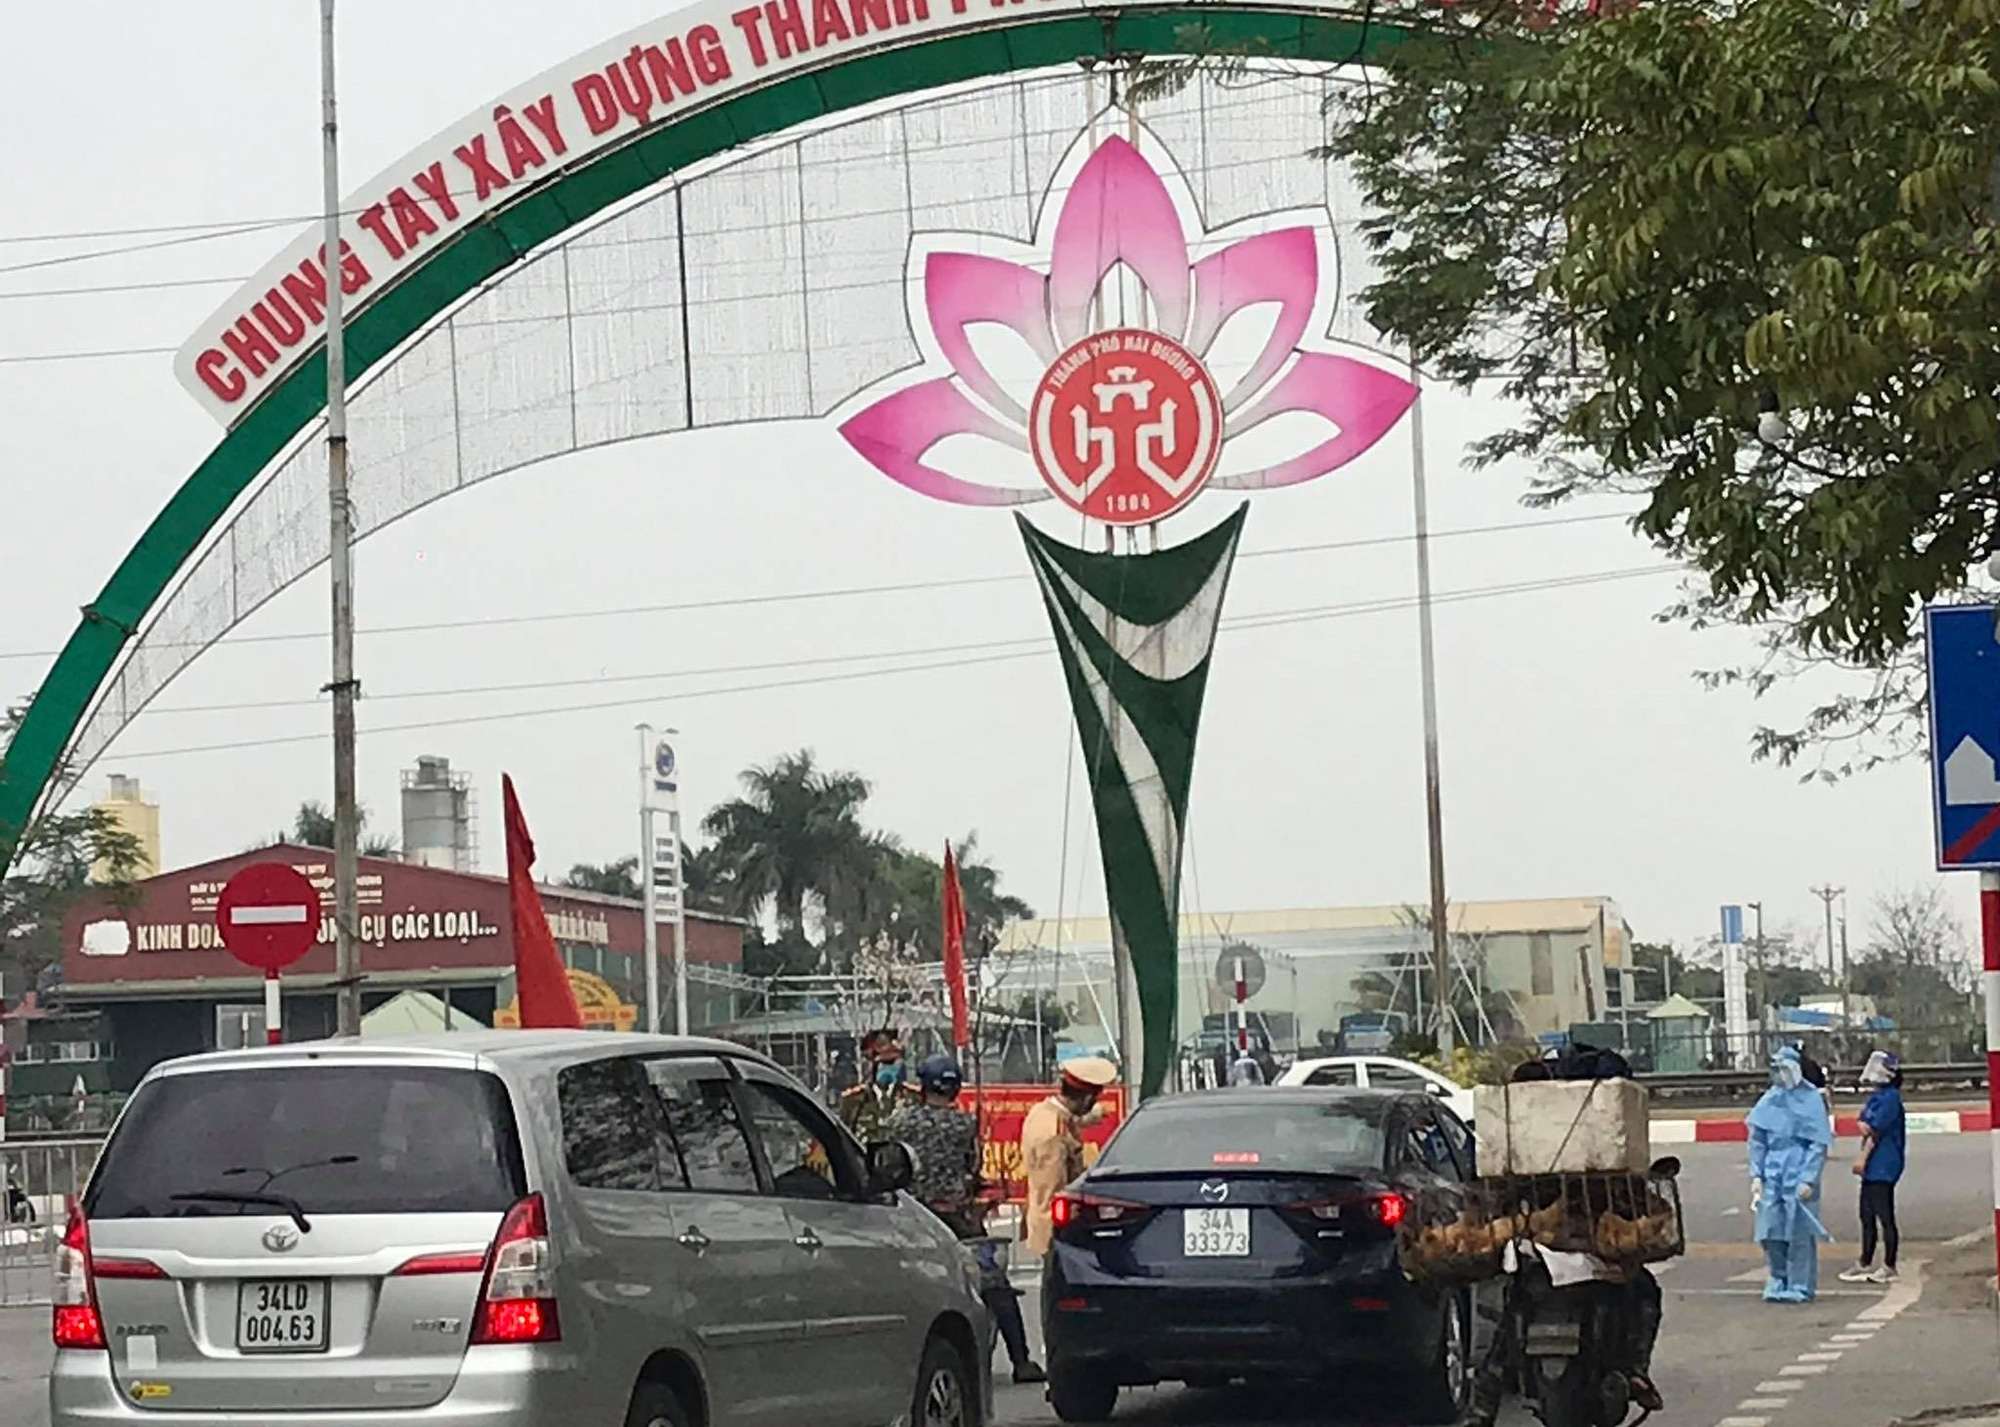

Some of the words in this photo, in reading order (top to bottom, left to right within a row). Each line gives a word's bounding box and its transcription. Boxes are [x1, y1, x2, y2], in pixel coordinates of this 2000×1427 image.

[195, 238, 372, 403] CHUNG
[357, 161, 461, 260] TAY
[453, 104, 568, 200] XÂY
[571, 23, 732, 127] DỰNG
[136, 924, 183, 952] KINH
[188, 923, 226, 950] DOA
[361, 914, 387, 948] CỤ
[391, 904, 430, 941] CÁC
[1199, 1209, 1234, 1231] 34A
[257, 1283, 308, 1311] 34LD
[247, 1315, 315, 1342] 004.63
